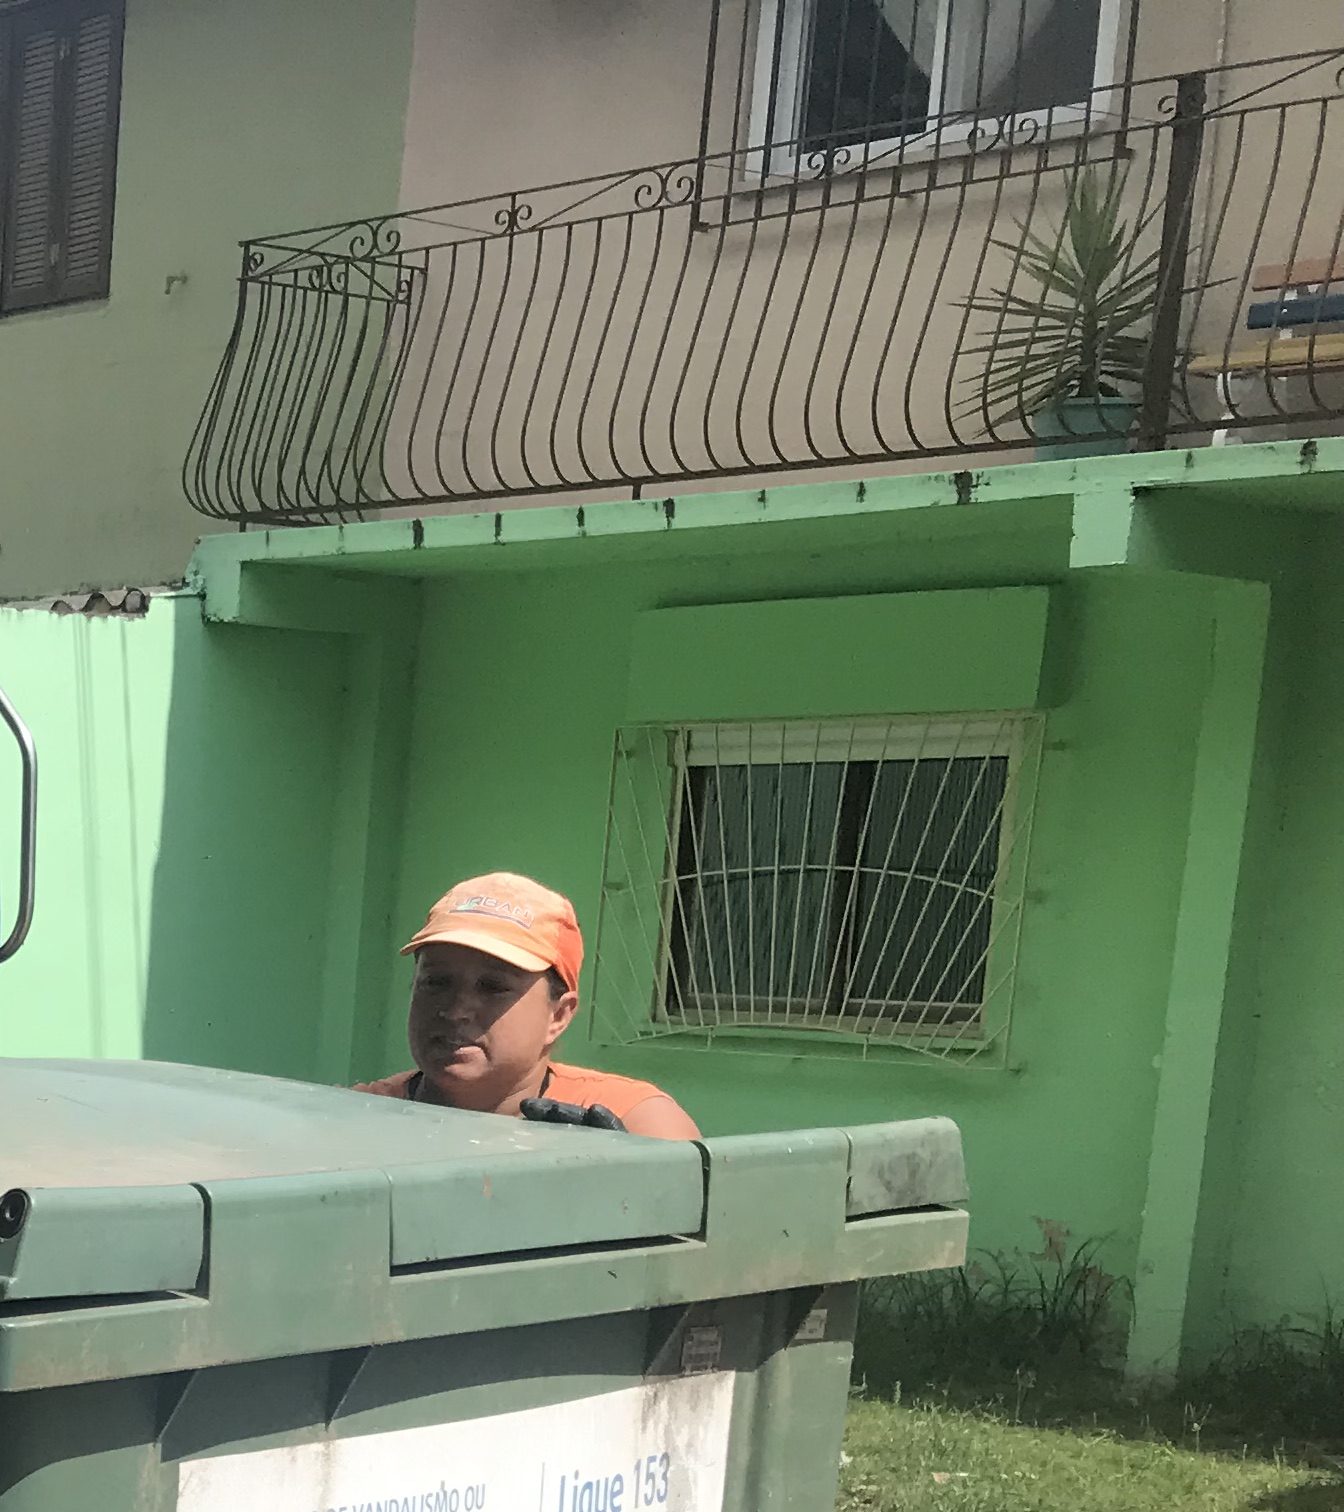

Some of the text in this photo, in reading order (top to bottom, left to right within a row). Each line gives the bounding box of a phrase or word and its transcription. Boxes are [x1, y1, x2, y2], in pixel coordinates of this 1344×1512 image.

[455, 895, 530, 919] URBAN
[633, 1451, 671, 1509] 153
[464, 1483, 487, 1512] OU
